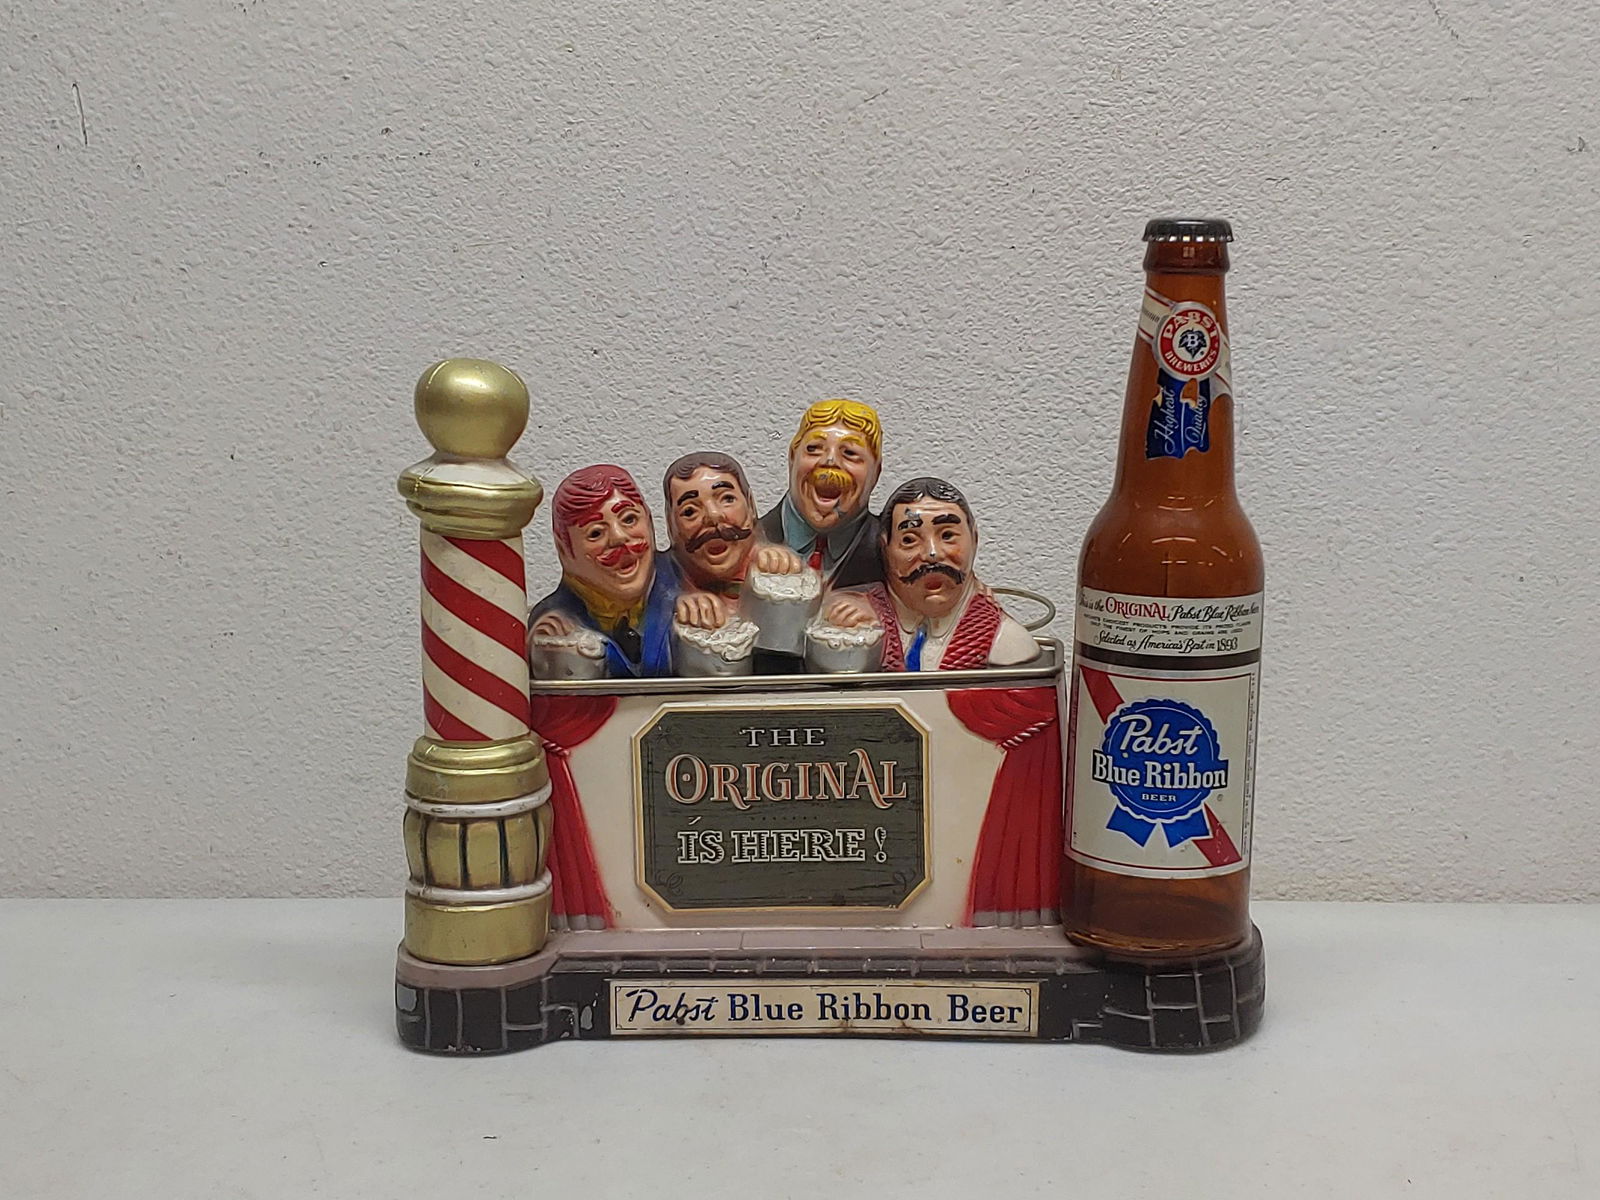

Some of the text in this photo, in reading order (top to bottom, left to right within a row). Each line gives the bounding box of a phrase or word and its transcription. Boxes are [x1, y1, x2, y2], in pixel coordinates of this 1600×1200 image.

[1163, 311, 1218, 339] PABST
[1164, 349, 1217, 372] BREWERIES
[1154, 385, 1179, 455] Highest
[1184, 395, 1208, 448] Quality
[1105, 596, 1169, 621] ORIGINAL
[1168, 604, 1202, 622] Pabst
[1198, 605, 1225, 622] Blue
[1094, 630, 1238, 654] Selected as America's Best in 1893
[739, 727, 825, 747] THE
[1120, 714, 1203, 758] Pabst
[665, 748, 907, 810] ORIGINAL
[1093, 752, 1226, 790] Blue Ribbon
[1141, 793, 1177, 802] BEER
[625, 989, 1023, 1024] Pabst Blue Ribbon Beer
